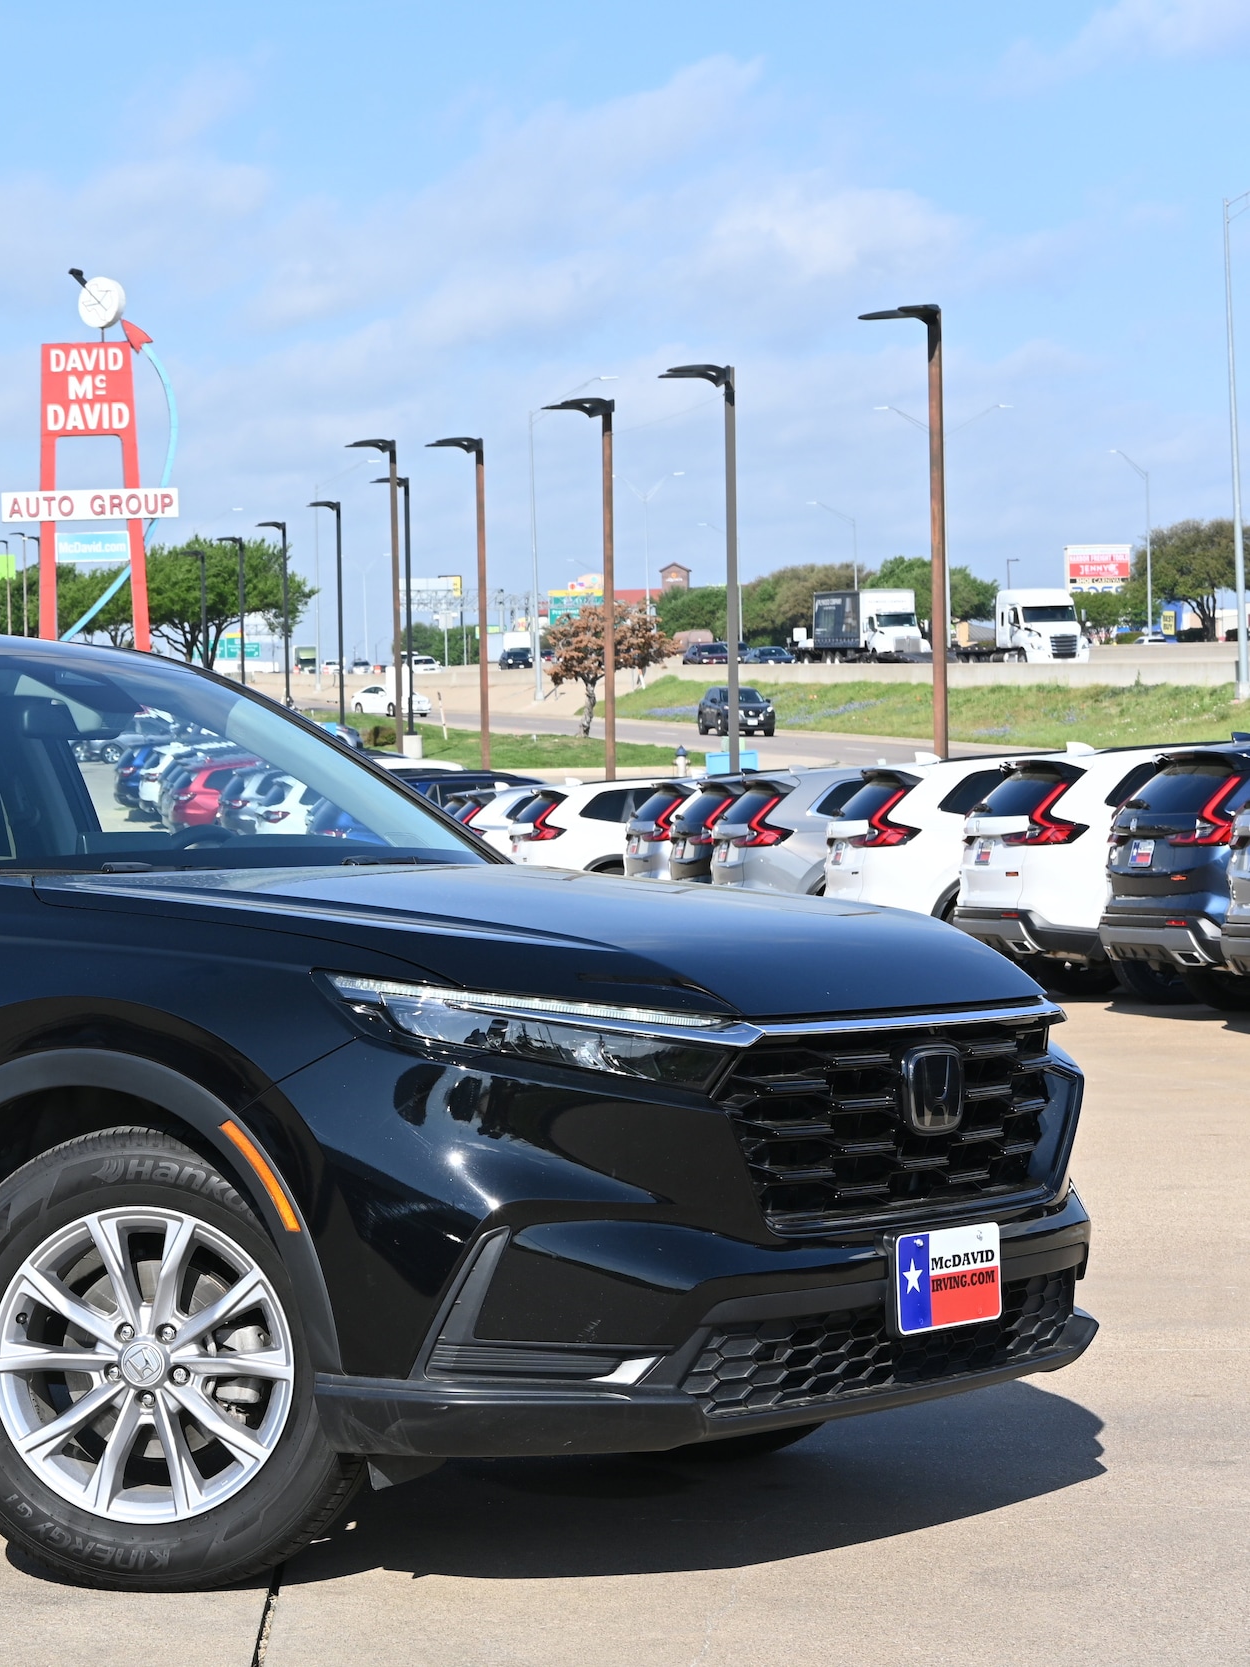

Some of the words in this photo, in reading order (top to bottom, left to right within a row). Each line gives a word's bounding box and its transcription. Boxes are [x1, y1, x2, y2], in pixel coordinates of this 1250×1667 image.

[50, 347, 124, 372] DAVID
[67, 374, 107, 400] Mc
[46, 402, 130, 431] DAVID
[9, 495, 75, 519] AUTO
[90, 493, 174, 516] GROUP
[58, 540, 127, 554] McDavid.com
[931, 1249, 995, 1270] McDAVID
[931, 1270, 995, 1292] IRVING.COM
[31, 1521, 170, 1570] KINERGY
